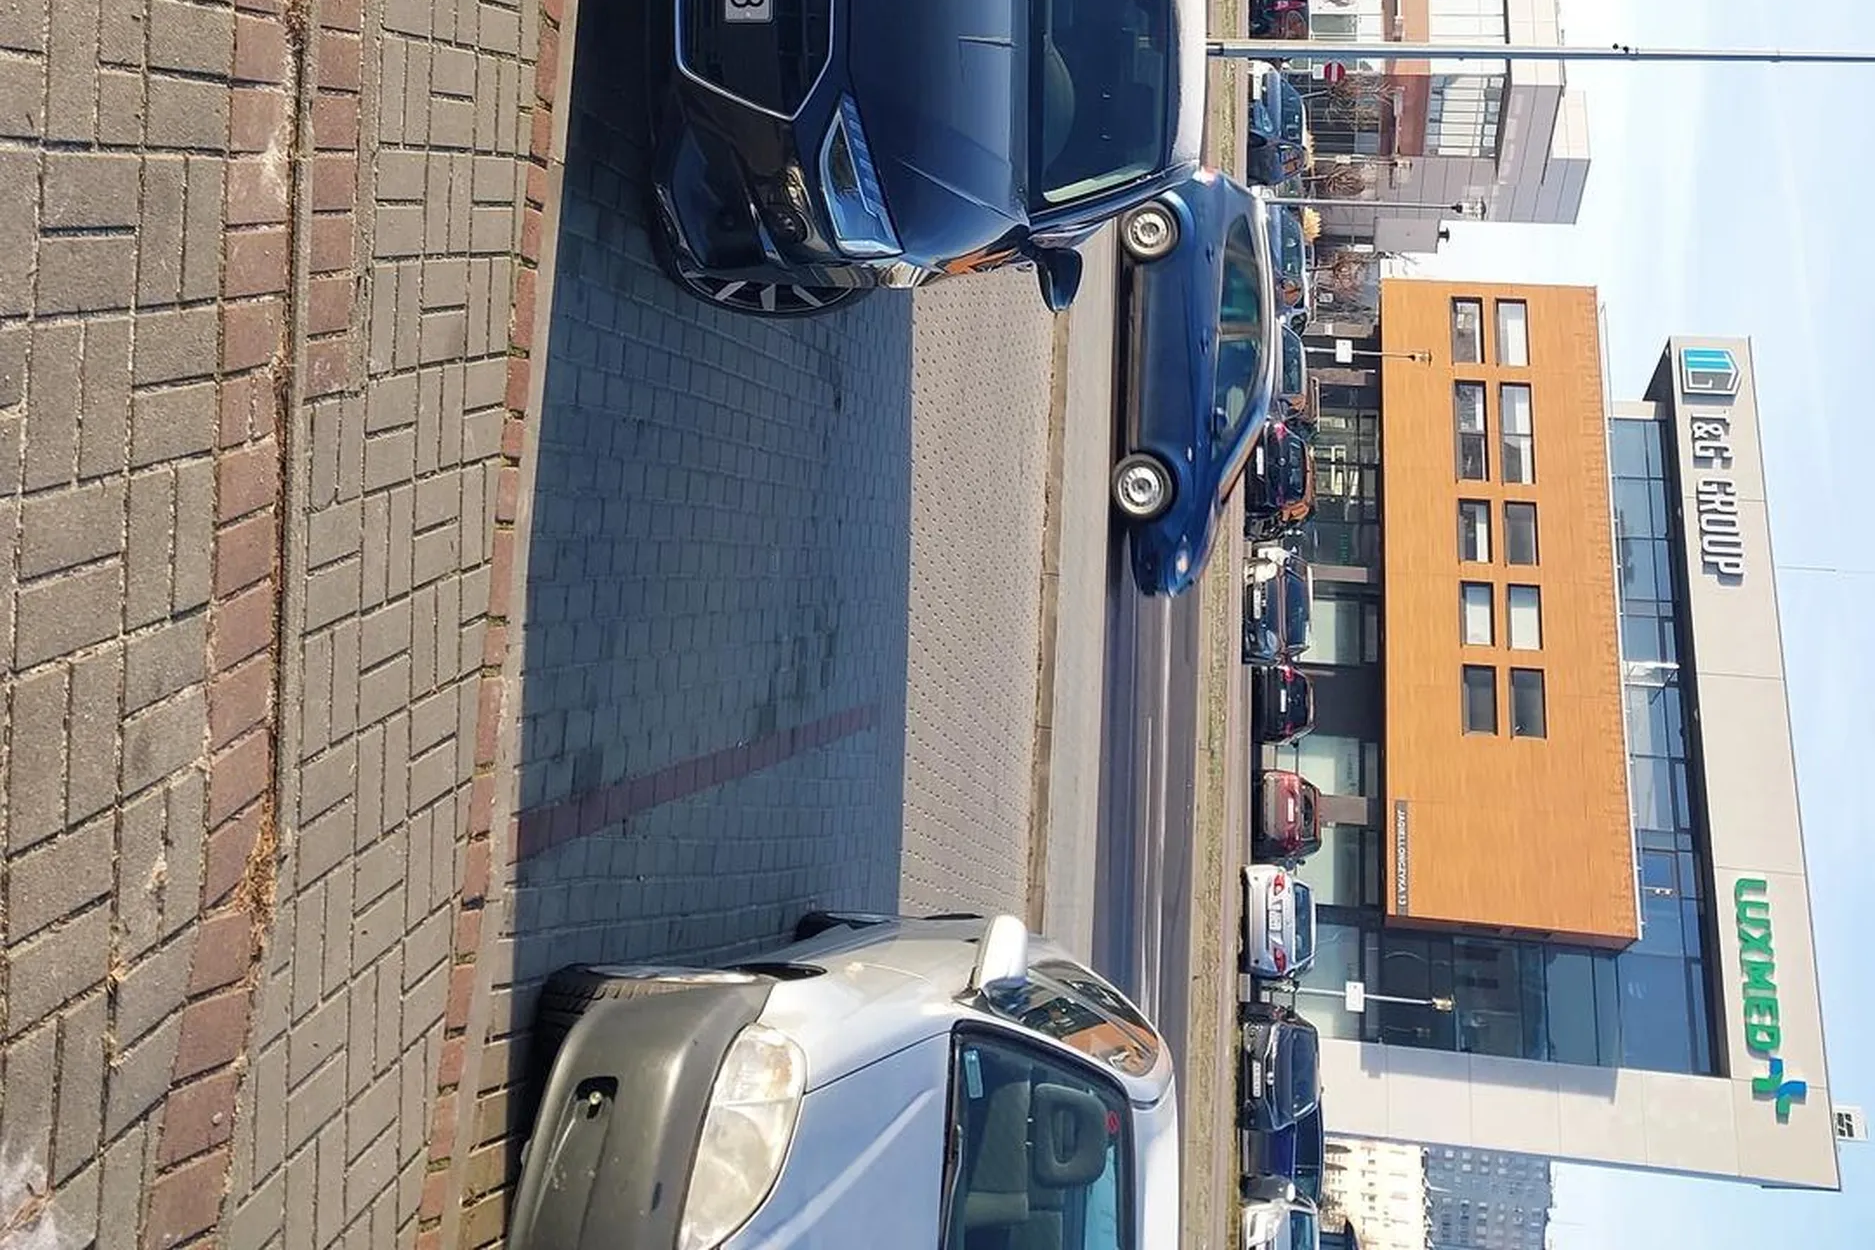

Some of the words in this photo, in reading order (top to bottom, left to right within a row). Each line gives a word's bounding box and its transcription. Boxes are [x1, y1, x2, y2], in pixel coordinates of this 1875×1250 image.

[1691, 410, 1734, 459] T&G
[1696, 477, 1748, 575] GROUP
[1735, 878, 1781, 1051] LUXMED
